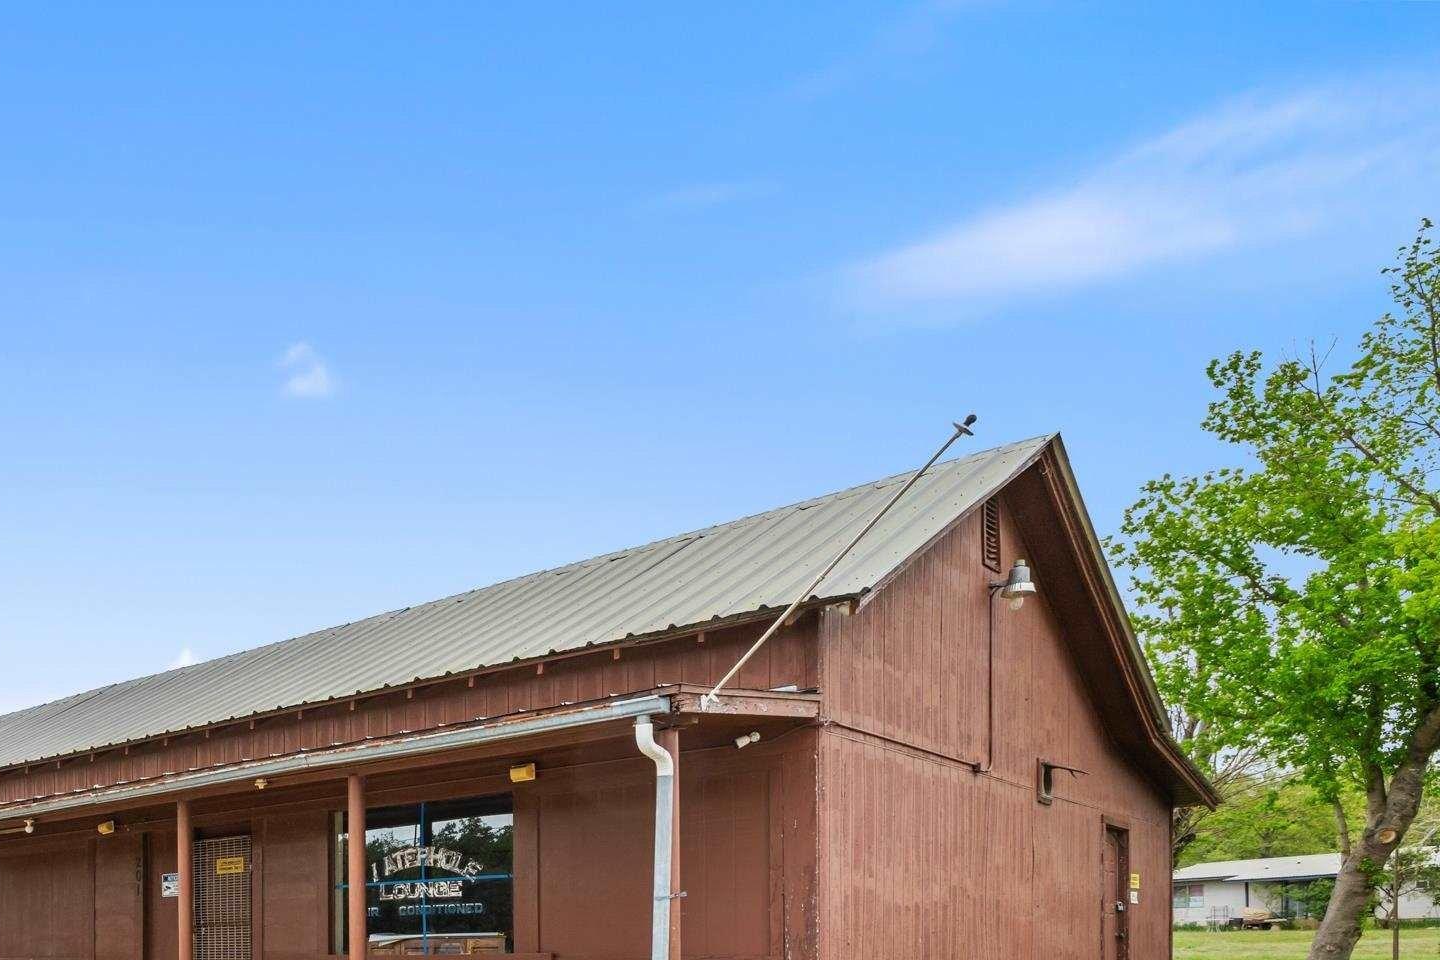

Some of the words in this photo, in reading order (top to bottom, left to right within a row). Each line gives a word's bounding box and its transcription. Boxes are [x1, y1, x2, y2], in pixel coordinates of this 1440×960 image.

[371, 846, 484, 884] ATERHOLE
[379, 881, 463, 901] LOUNGE
[398, 902, 484, 917] CONDITIONED
